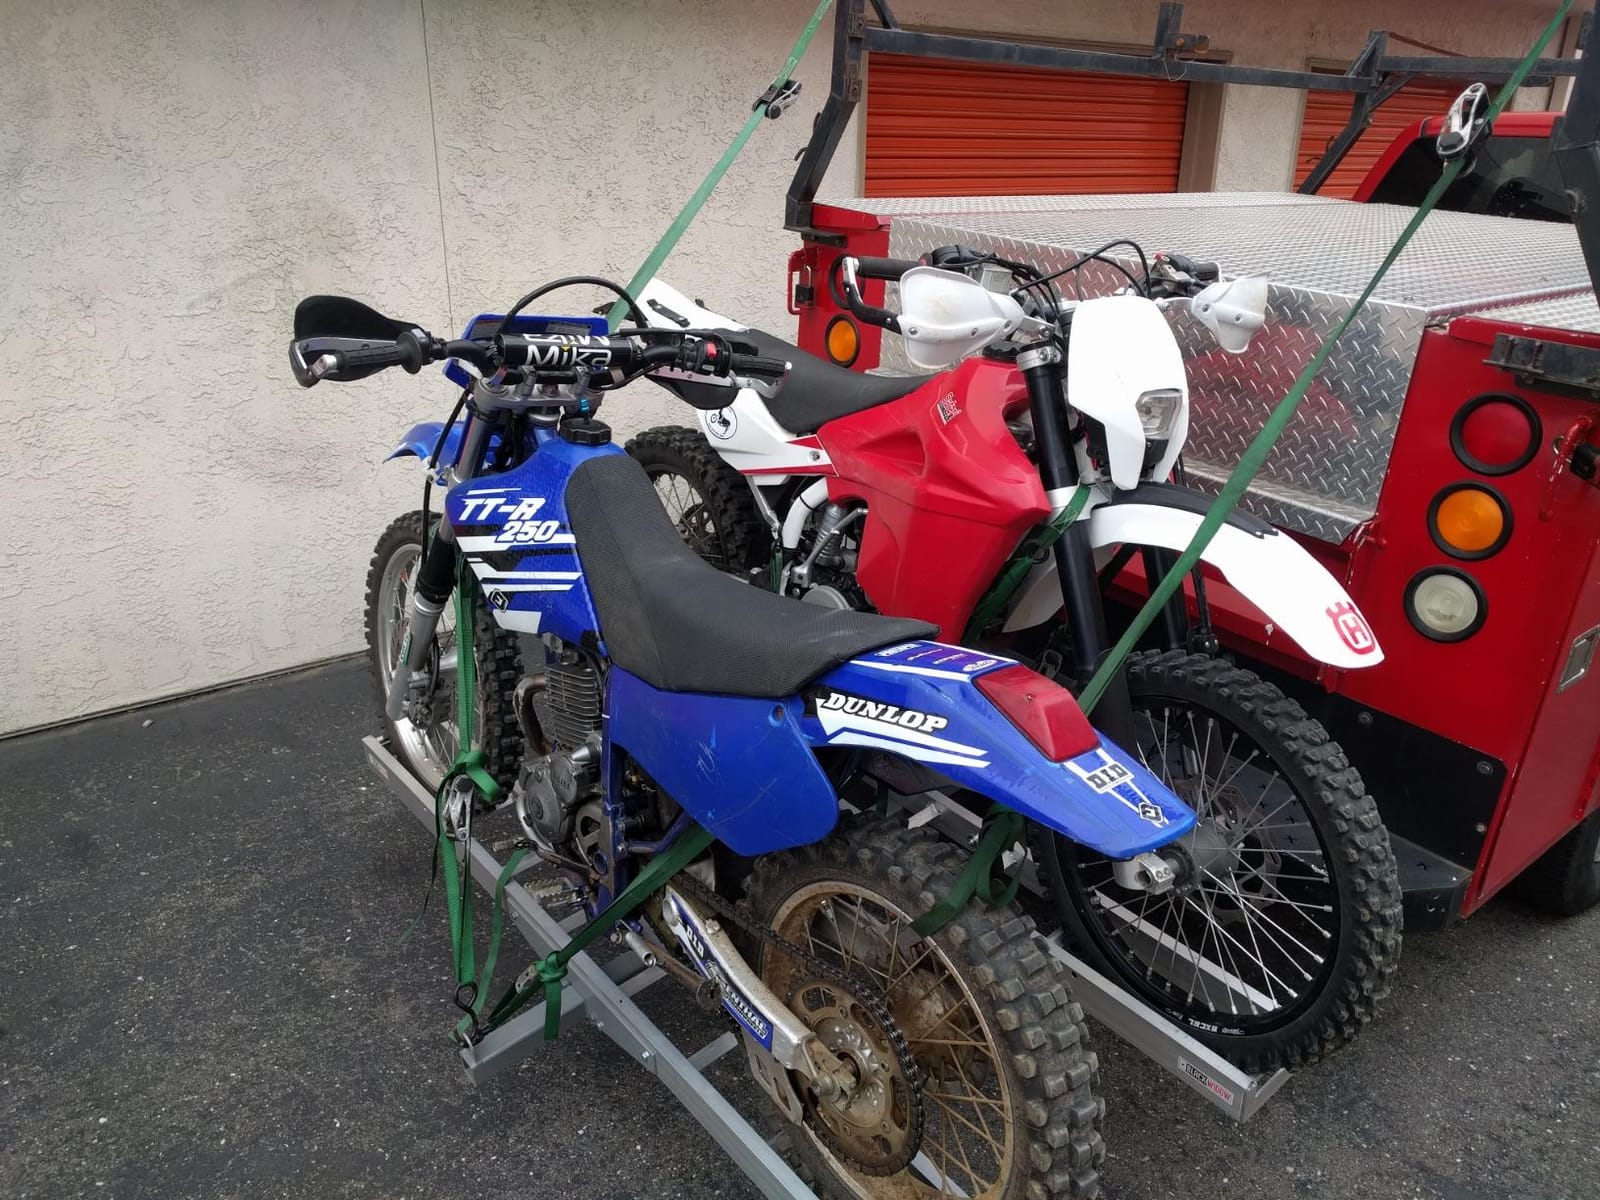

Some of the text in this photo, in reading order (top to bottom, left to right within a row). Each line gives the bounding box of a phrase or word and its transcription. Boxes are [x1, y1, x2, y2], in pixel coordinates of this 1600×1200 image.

[526, 344, 611, 366] Mika
[459, 498, 546, 521] TT-R
[495, 520, 560, 543] 250
[821, 692, 948, 733] DUNLOP
